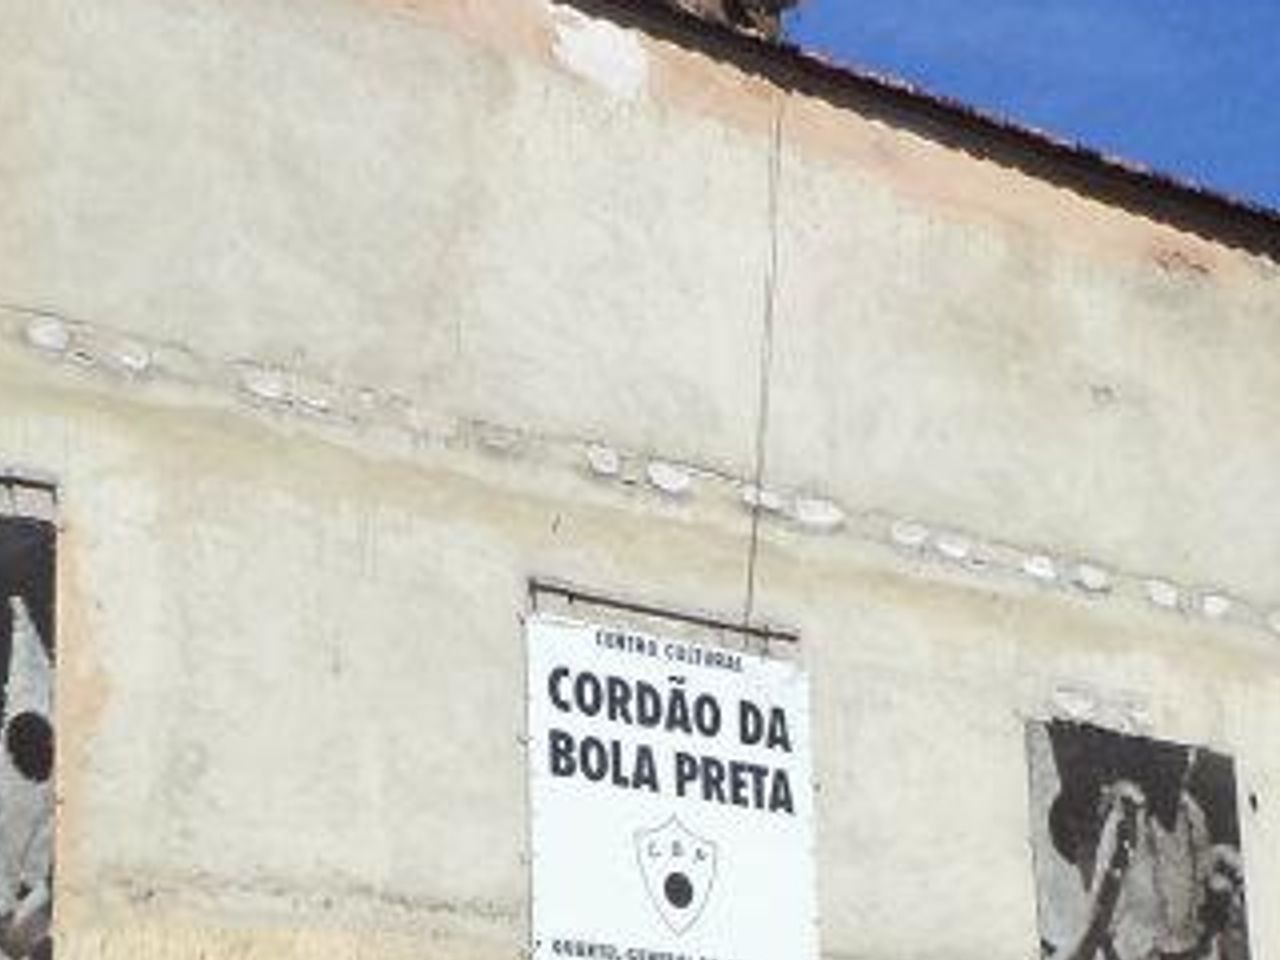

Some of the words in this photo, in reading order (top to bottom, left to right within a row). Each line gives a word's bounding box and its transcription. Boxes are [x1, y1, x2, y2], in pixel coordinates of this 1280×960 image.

[595, 631, 657, 657] CENTRO
[664, 642, 743, 673] CULTURAL
[547, 666, 721, 738] CORDÃO
[739, 698, 793, 753] DA
[547, 727, 660, 793] BOLA
[675, 750, 795, 815] PRETA
